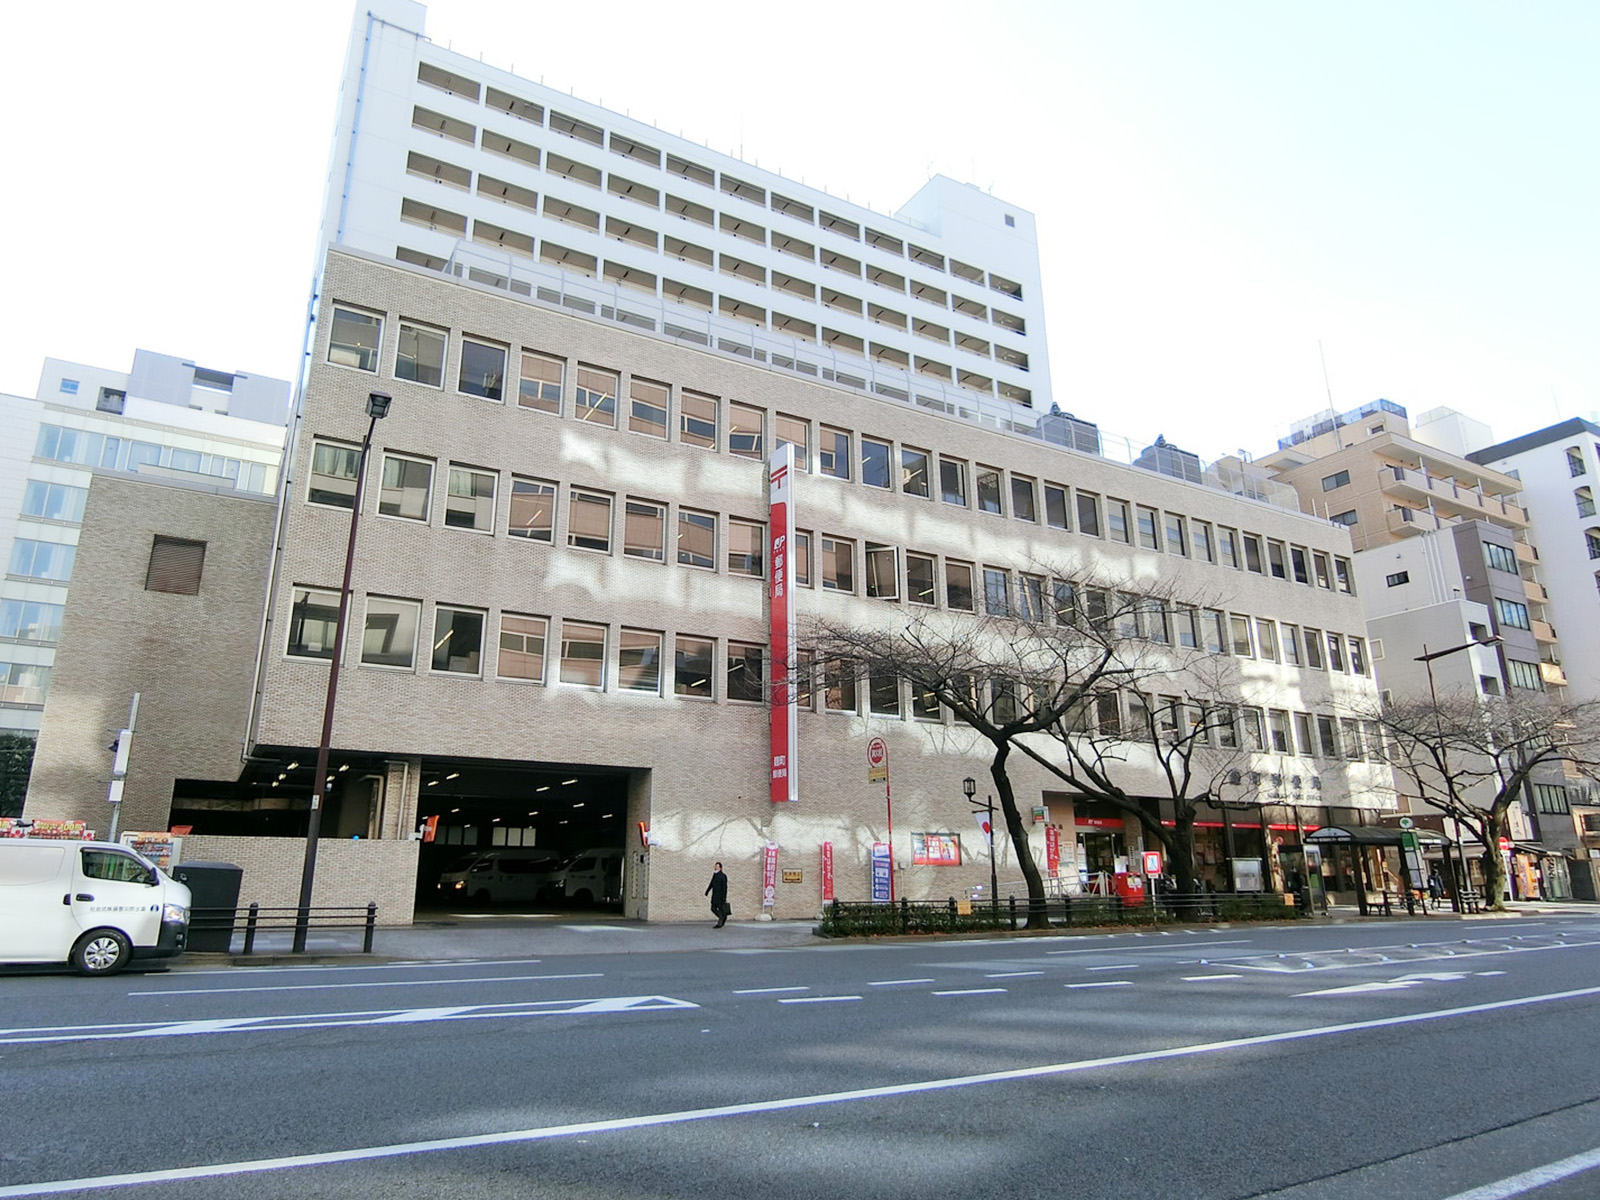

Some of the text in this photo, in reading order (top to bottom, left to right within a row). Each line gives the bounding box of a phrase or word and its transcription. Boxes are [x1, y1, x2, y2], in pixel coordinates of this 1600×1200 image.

[774, 554, 784, 598] 郵便局
[773, 768, 787, 779] 郵便局
